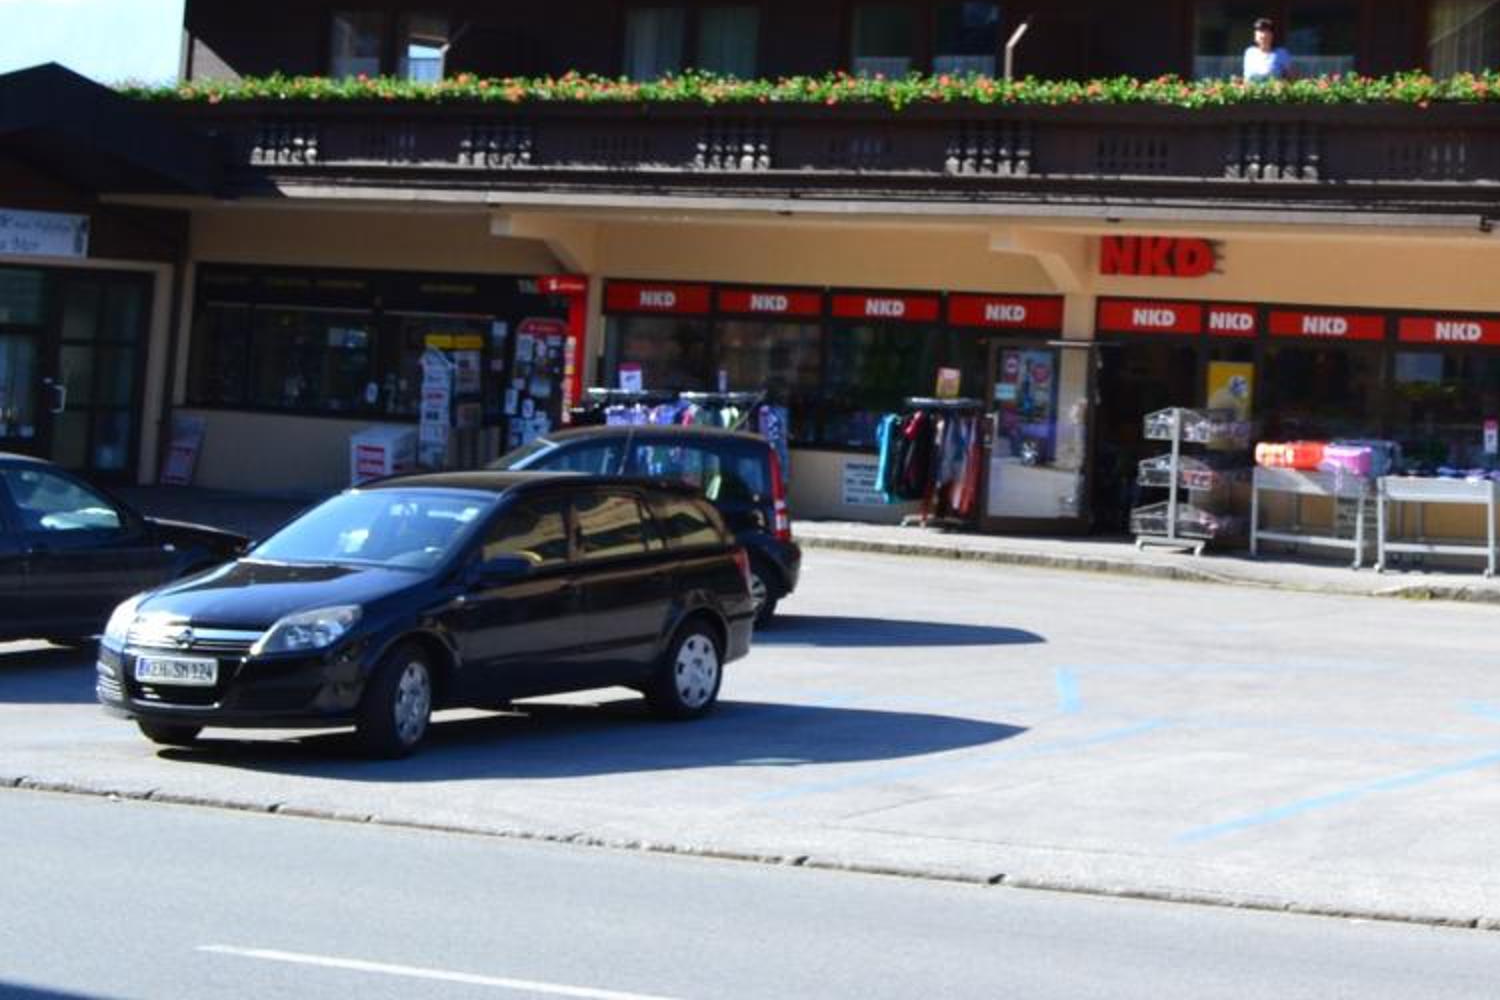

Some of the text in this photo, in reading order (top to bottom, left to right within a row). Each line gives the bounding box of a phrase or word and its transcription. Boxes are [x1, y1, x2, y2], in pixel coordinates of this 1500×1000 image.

[1101, 236, 1215, 278] NKD
[640, 291, 675, 307] NKD
[750, 295, 787, 311] NKD
[865, 299, 905, 317] NKD
[985, 304, 1026, 322] NKD
[1132, 308, 1176, 327] NKD
[1209, 311, 1254, 331] NKD
[1302, 315, 1349, 336] NKD
[1434, 321, 1483, 342] NKD
